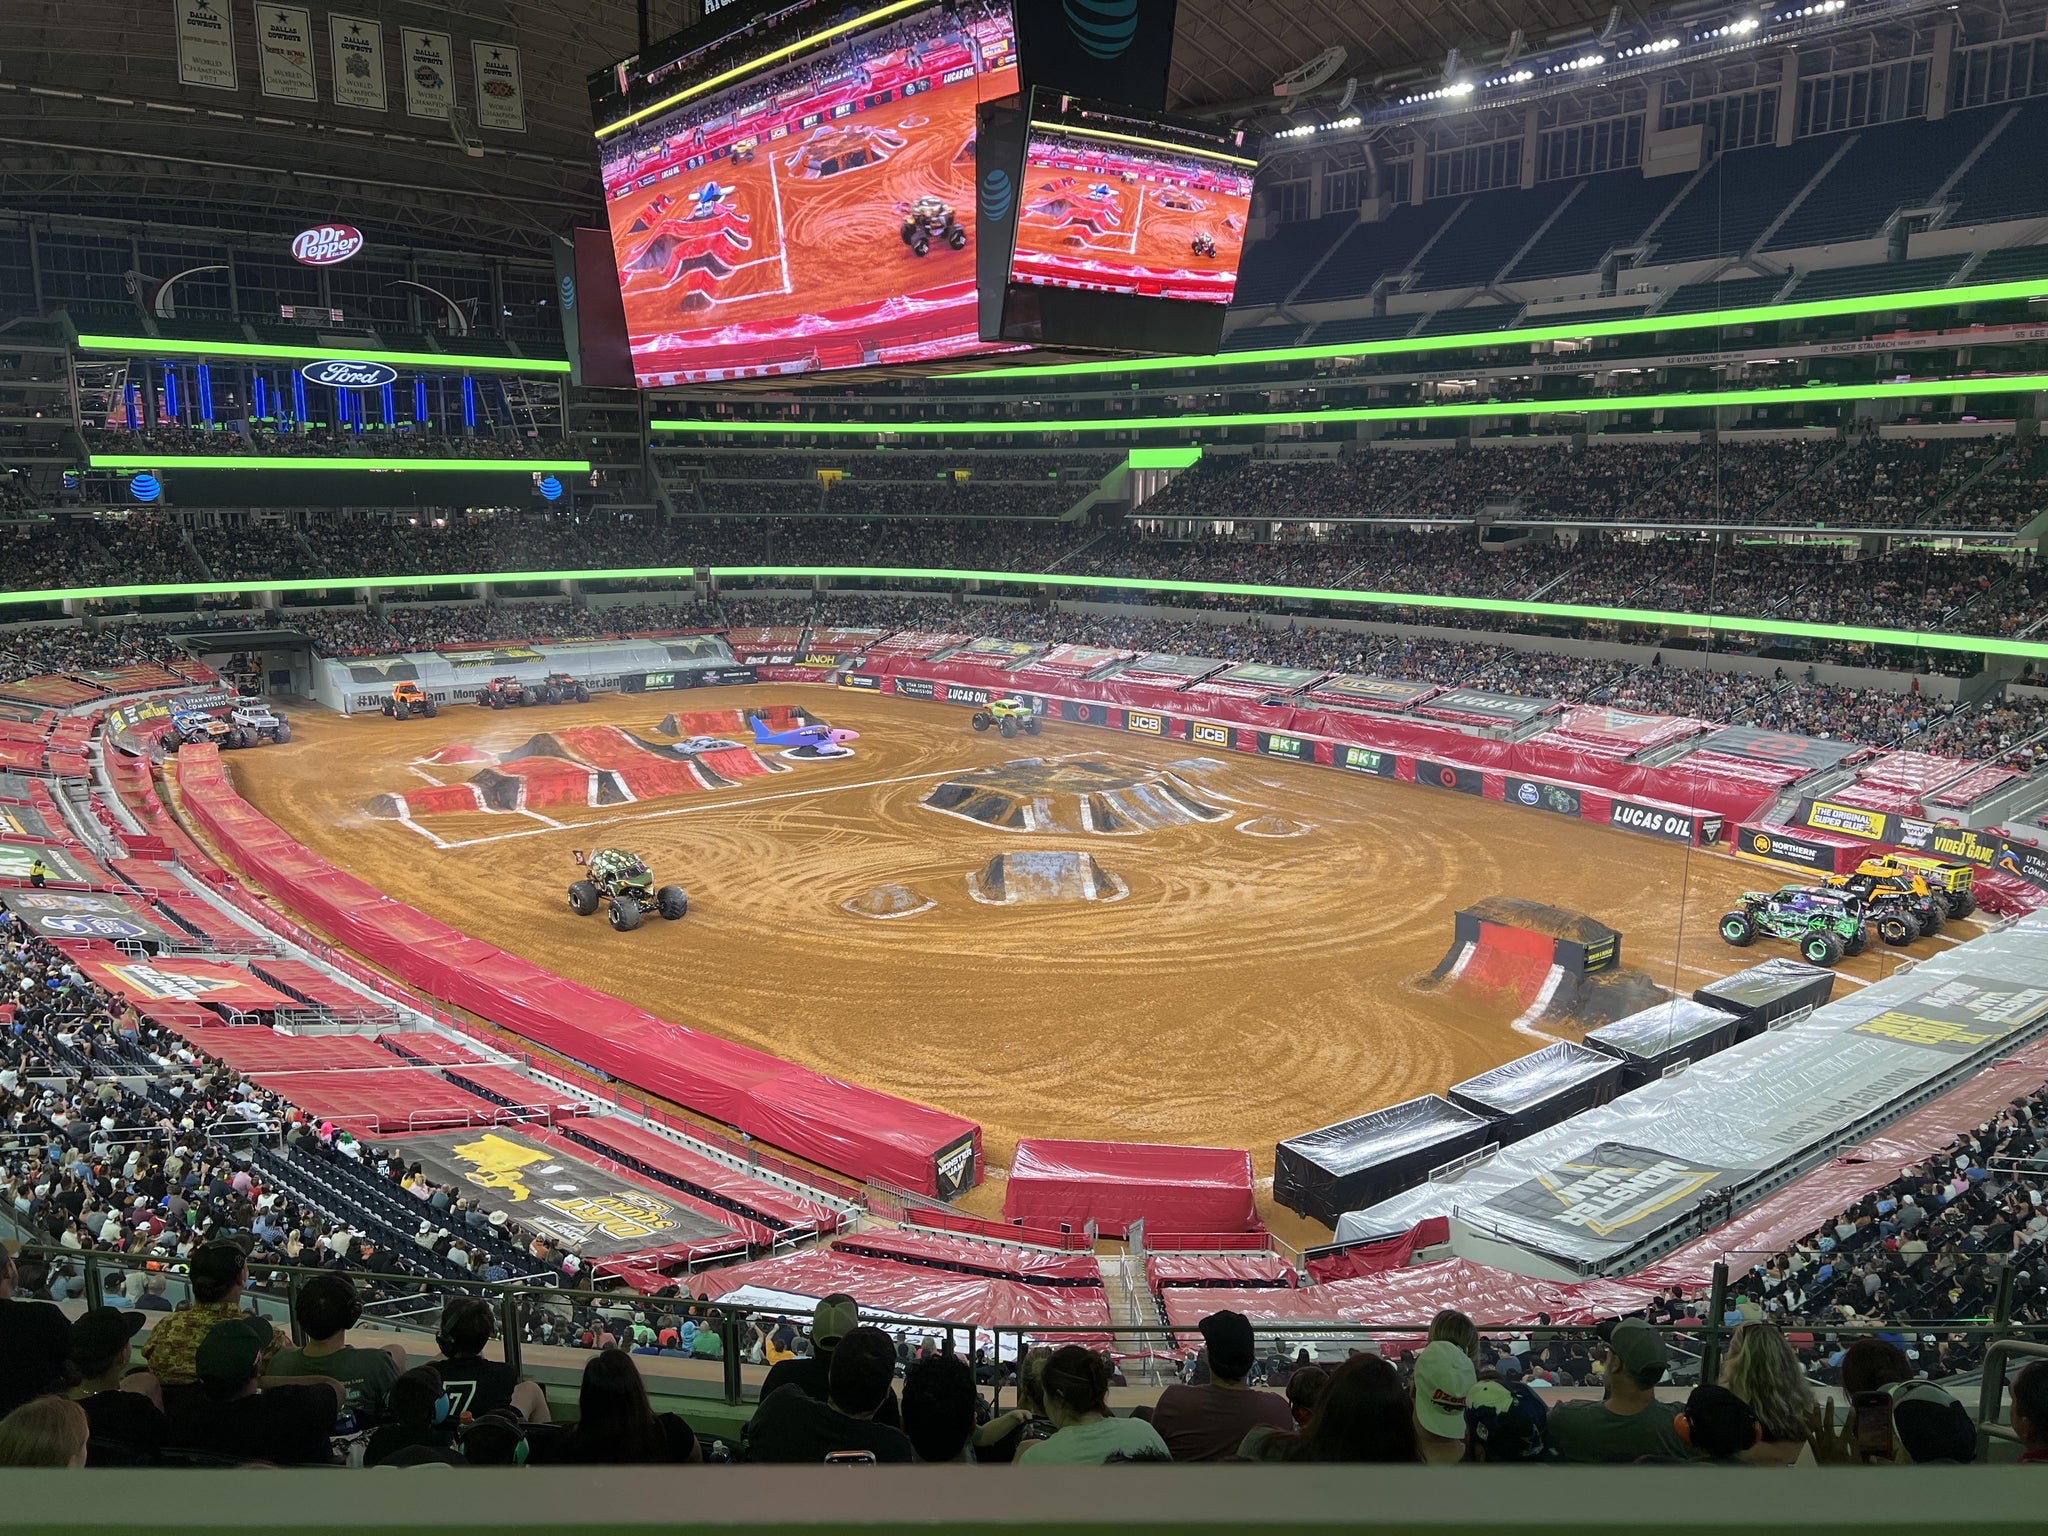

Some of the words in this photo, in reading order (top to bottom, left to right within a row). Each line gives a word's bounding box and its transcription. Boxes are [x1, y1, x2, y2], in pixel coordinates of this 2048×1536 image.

[190, 11, 218, 21] DALLAS
[187, 18, 222, 30] COWBOYS
[271, 25, 297, 34] DALLAS
[268, 32, 301, 42] COWBOYS
[344, 36, 370, 46] DALLAS
[341, 43, 372, 54] COWBOYS
[416, 49, 440, 58] DALLAS
[413, 56, 444, 66] COWBOYS
[486, 62, 509, 70] DALLAS
[484, 68, 512, 78] COWBOYS
[944, 70, 962, 84] LUCAS
[963, 66, 975, 78] OIL
[320, 228, 344, 246] Dr
[298, 230, 358, 260] Pepper
[1832, 344, 1856, 352] ROGER
[1858, 341, 1896, 350] STAUBACH
[1693, 354, 1720, 362] PERKINS
[320, 362, 380, 384] Ford
[805, 654, 835, 664] UNOH
[646, 674, 674, 687] BKT
[948, 688, 974, 702] LUCAS
[974, 690, 988, 703] OIL
[1444, 694, 1509, 708] LUCAS
[1504, 703, 1540, 712] OIL
[1132, 716, 1159, 730] JCB
[1196, 726, 1225, 742] JCB
[1270, 738, 1300, 751] BKT
[1346, 751, 1380, 766] BKT
[1614, 806, 1662, 832] LUCAS
[1664, 818, 1692, 838] OIL
[1816, 807, 1832, 816] THE
[1833, 810, 1871, 824] ORIGINAL
[1814, 815, 1842, 828] SUPER
[1842, 820, 1866, 832] GLUE
[1962, 832, 1978, 845] THE
[1772, 841, 1817, 857] NORTHERN
[1934, 836, 1966, 856] VIDEO
[1966, 844, 1995, 863] GAME
[2026, 855, 2047, 868] UTAH
[938, 1148, 972, 1176] MONSTER
[948, 1161, 964, 1176] JAM
[1556, 1168, 1622, 1199] JAM
[1552, 1160, 1690, 1226] MONSTER
[443, 1380, 476, 1416] 7
